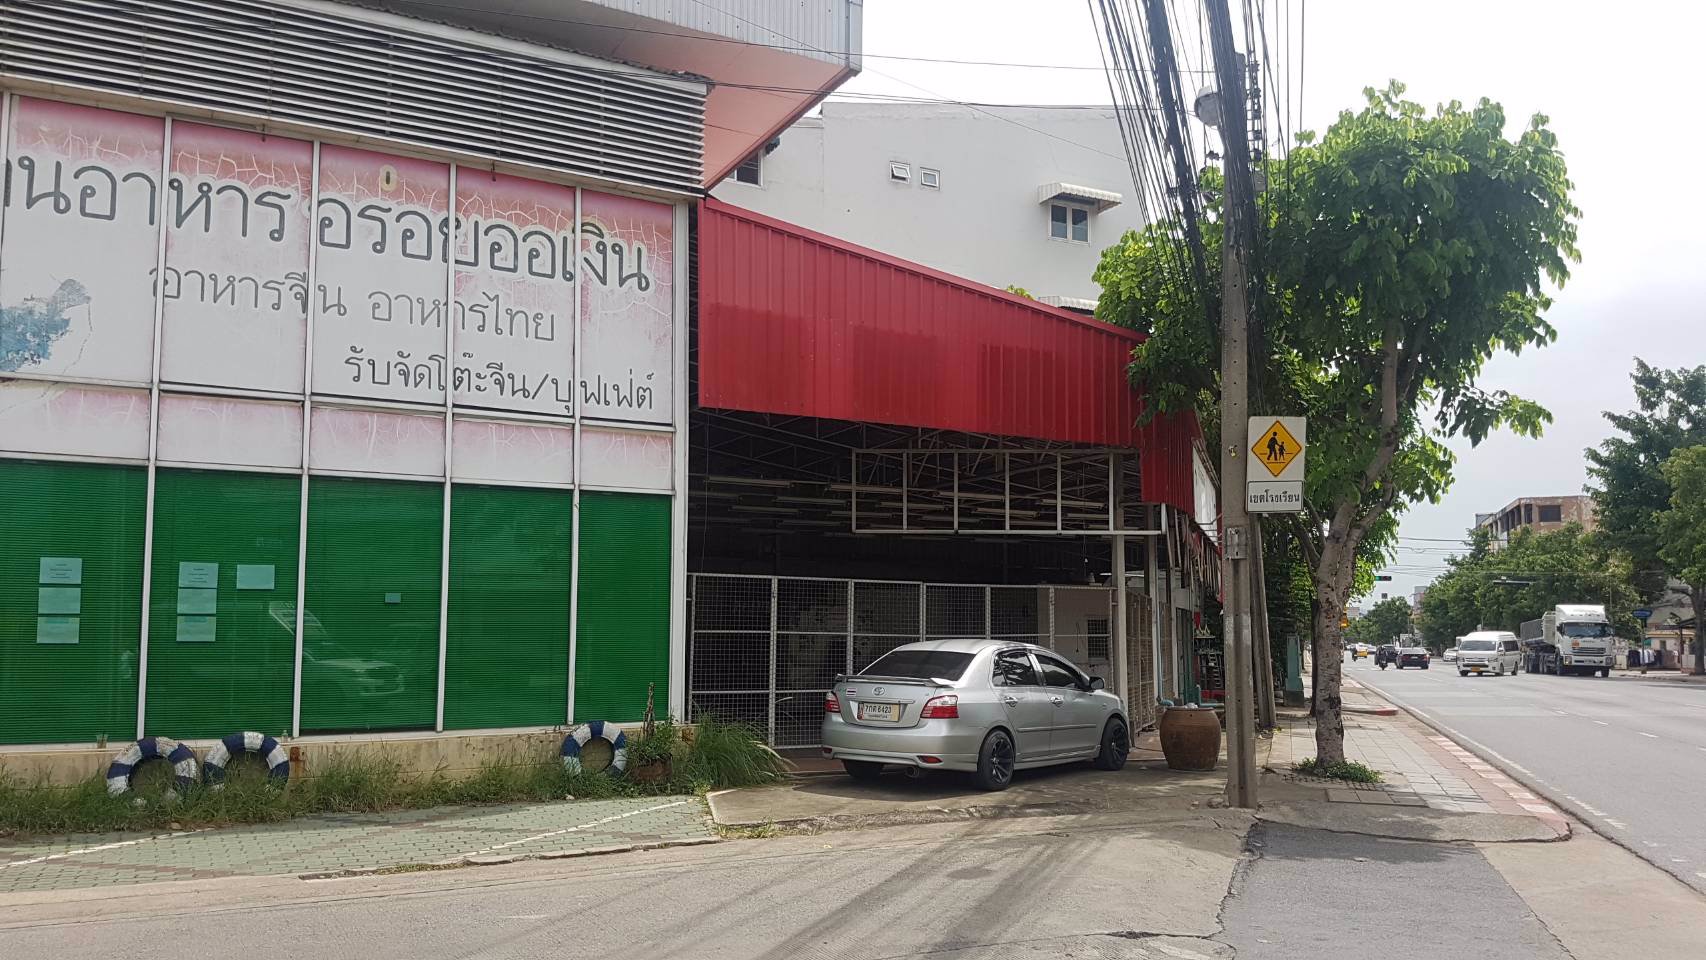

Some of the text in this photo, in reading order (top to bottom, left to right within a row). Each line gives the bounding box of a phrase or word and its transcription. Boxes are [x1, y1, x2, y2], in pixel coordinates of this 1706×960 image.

[149, 266, 555, 341] อาหารจีน อาหารไทย
[1249, 488, 1300, 504] เขตโรงเรียน
